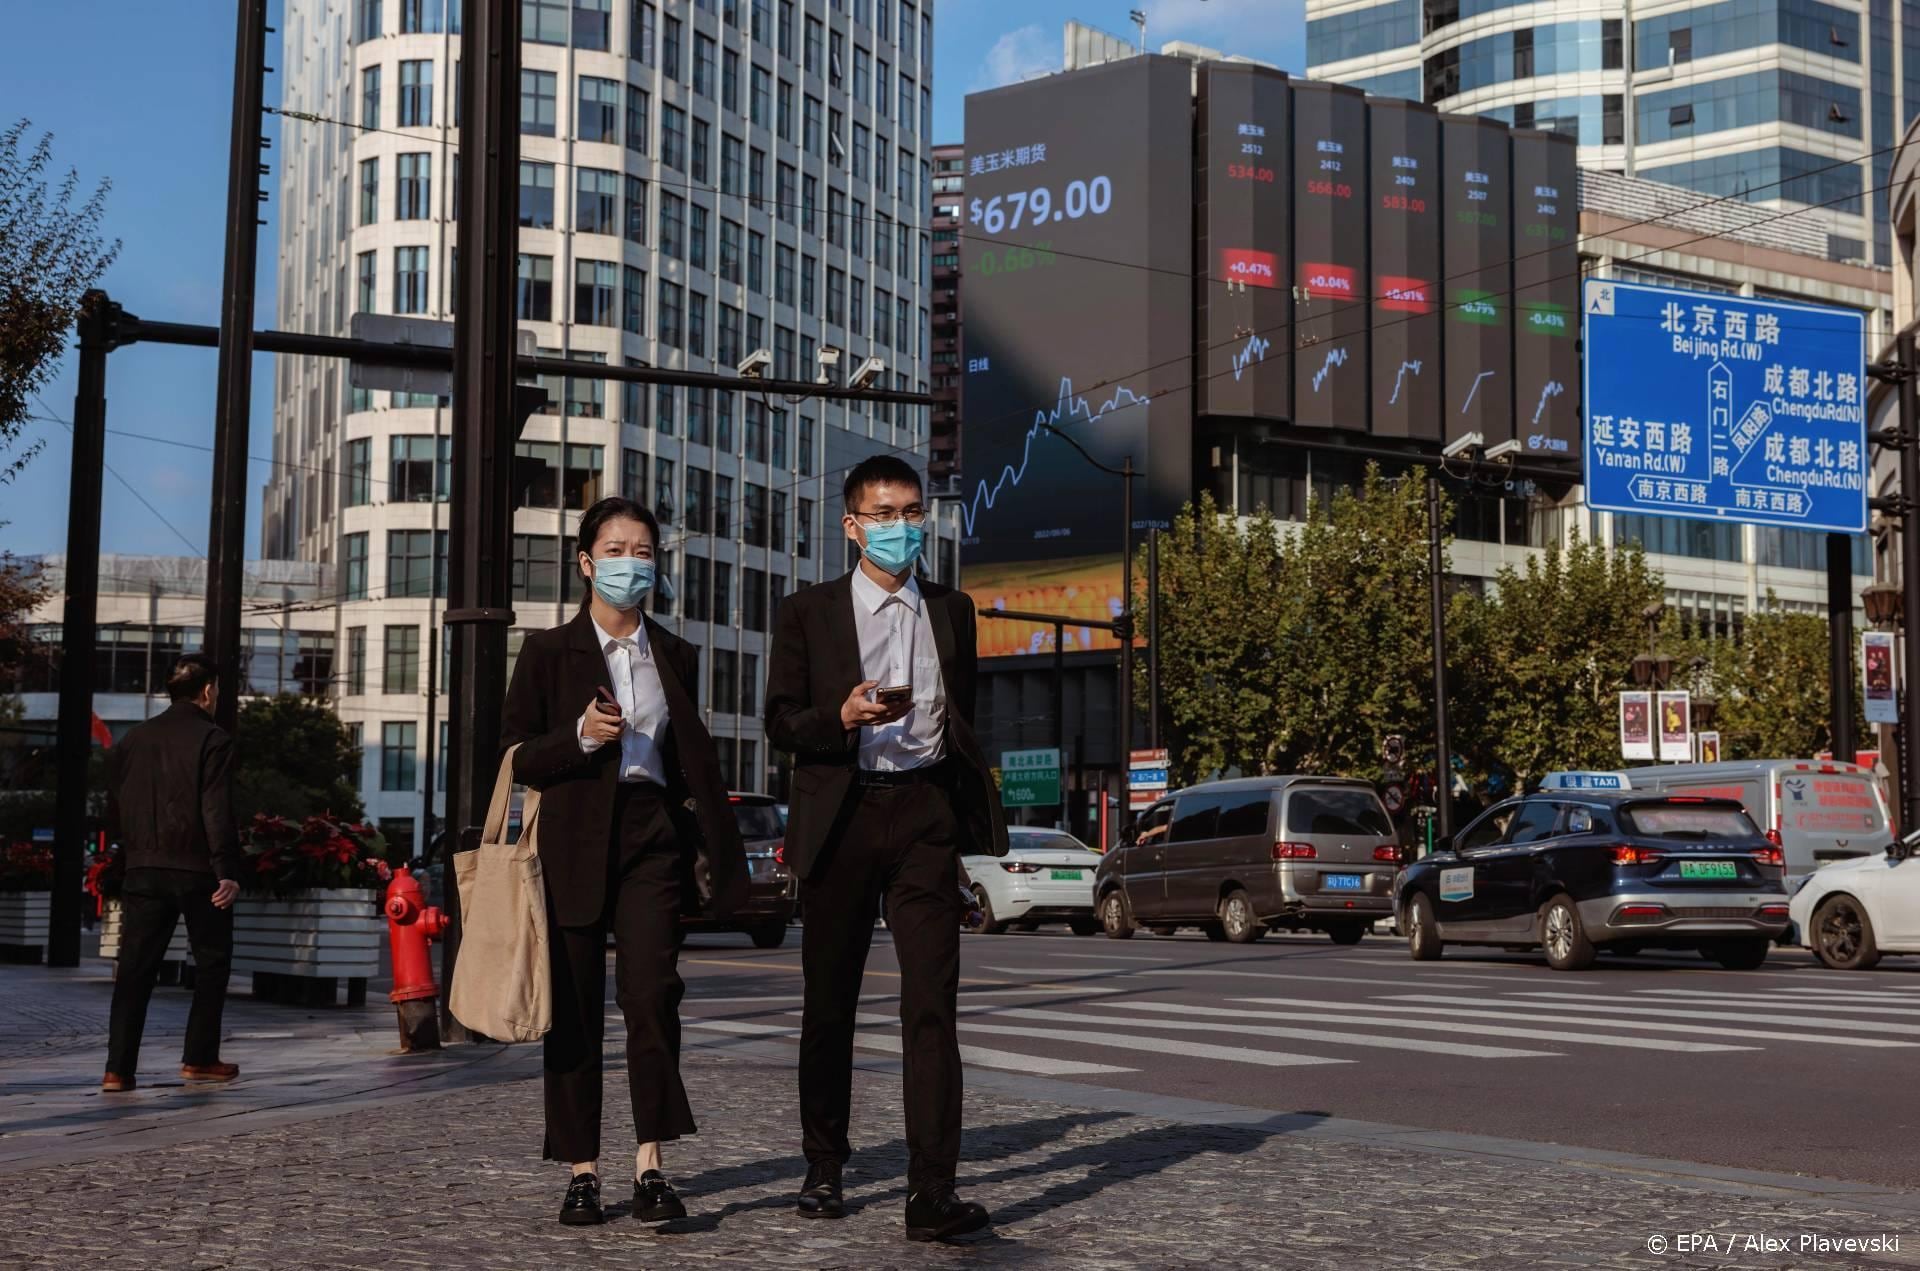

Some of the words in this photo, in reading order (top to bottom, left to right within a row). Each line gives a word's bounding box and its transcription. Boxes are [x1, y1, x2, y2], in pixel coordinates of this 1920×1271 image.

[970, 144, 1047, 176] 美玉米期货
[1241, 143, 1264, 156] 2512
[1228, 163, 1274, 183] 534.00
[1319, 159, 1342, 172] 2412
[970, 175, 1112, 234] $679.00
[1229, 261, 1272, 277] +0.47%
[1309, 275, 1350, 290] +0.04%
[1599, 288, 1611, 301] 北
[1661, 302, 1780, 344] 北京西路
[1673, 334, 1718, 361] Beijing
[1763, 363, 1858, 404] 成都北路
[1592, 415, 1693, 454] 延安西路
[1711, 379, 1729, 477] 石门二路
[1764, 432, 1860, 471] 成都北路
[1638, 478, 1707, 505] 南京西路
[1735, 487, 1803, 513] 南京西路
[1593, 778, 1617, 787] TAXI
